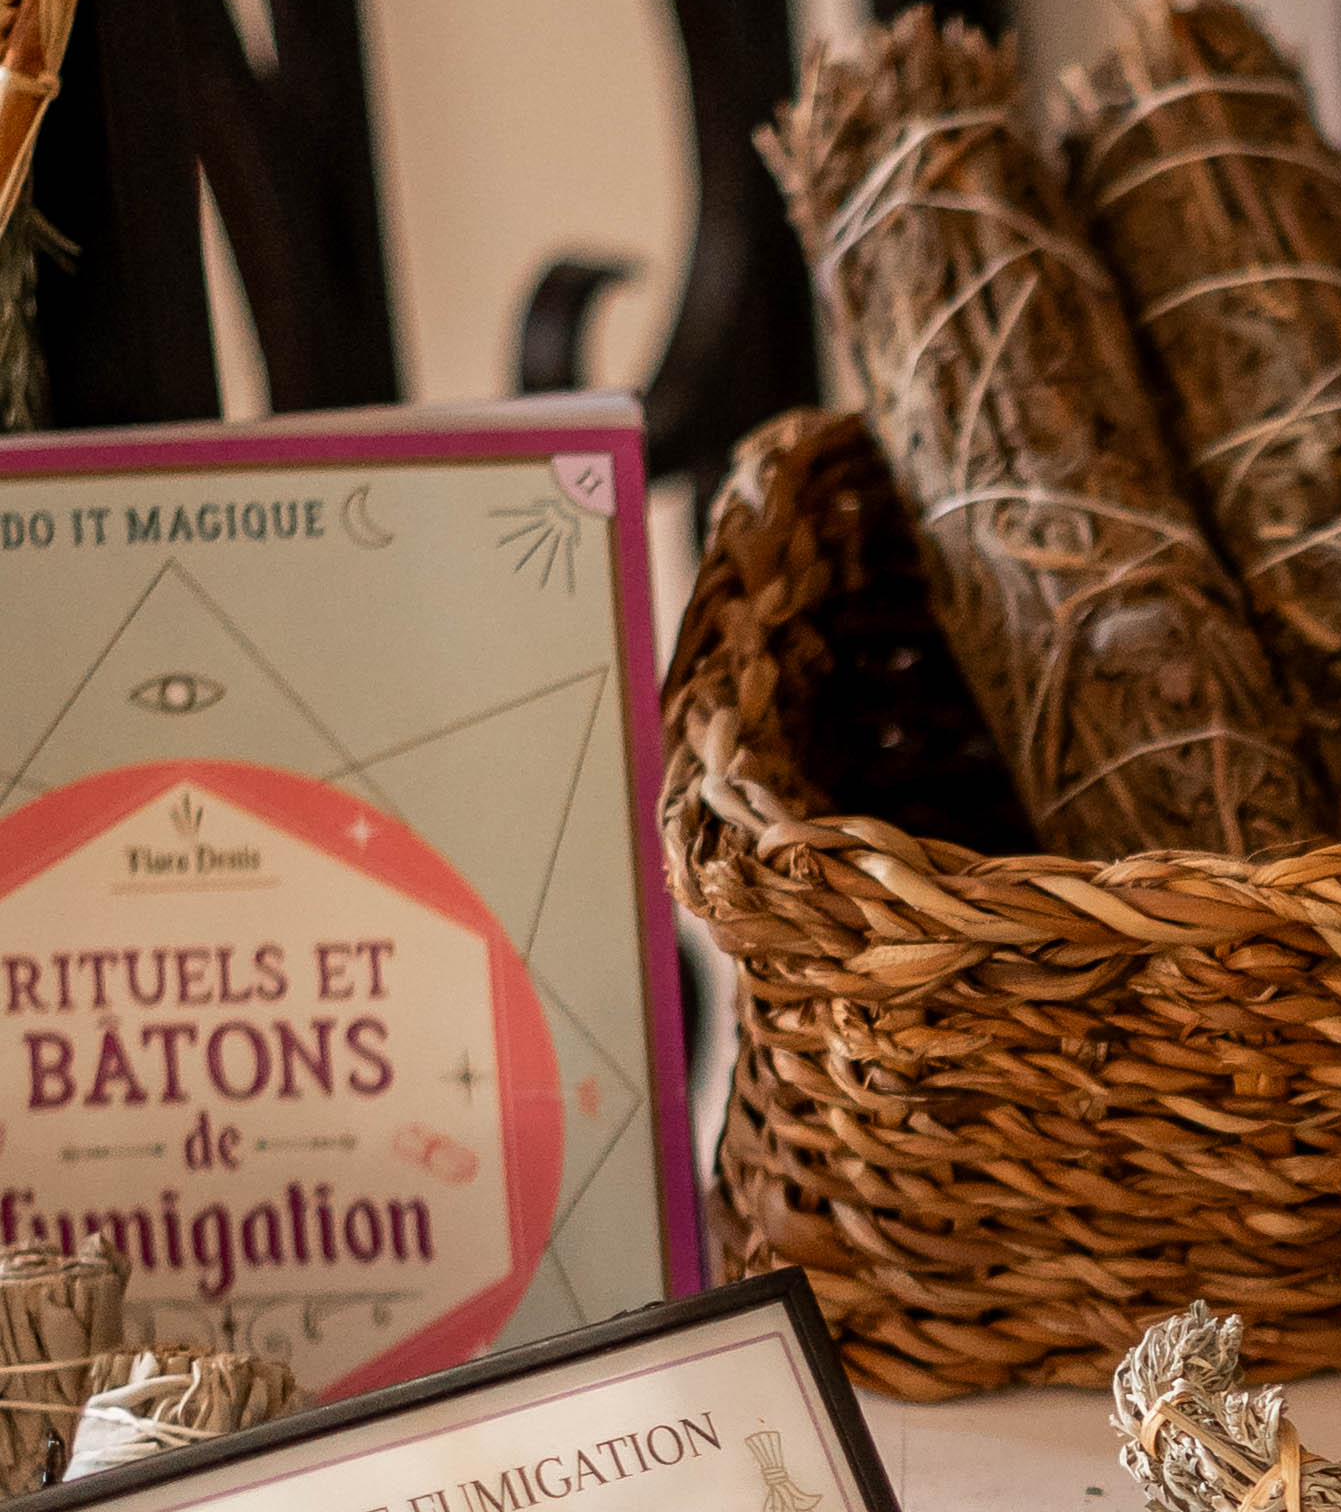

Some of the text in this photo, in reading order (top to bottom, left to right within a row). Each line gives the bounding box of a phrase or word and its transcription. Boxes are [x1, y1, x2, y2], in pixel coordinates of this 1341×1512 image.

[0, 499, 325, 550] DO IT MAGIQUE
[0, 938, 396, 1015] RITUELS ET
[22, 1012, 397, 1113] BÂTONS
[183, 1108, 243, 1171] de
